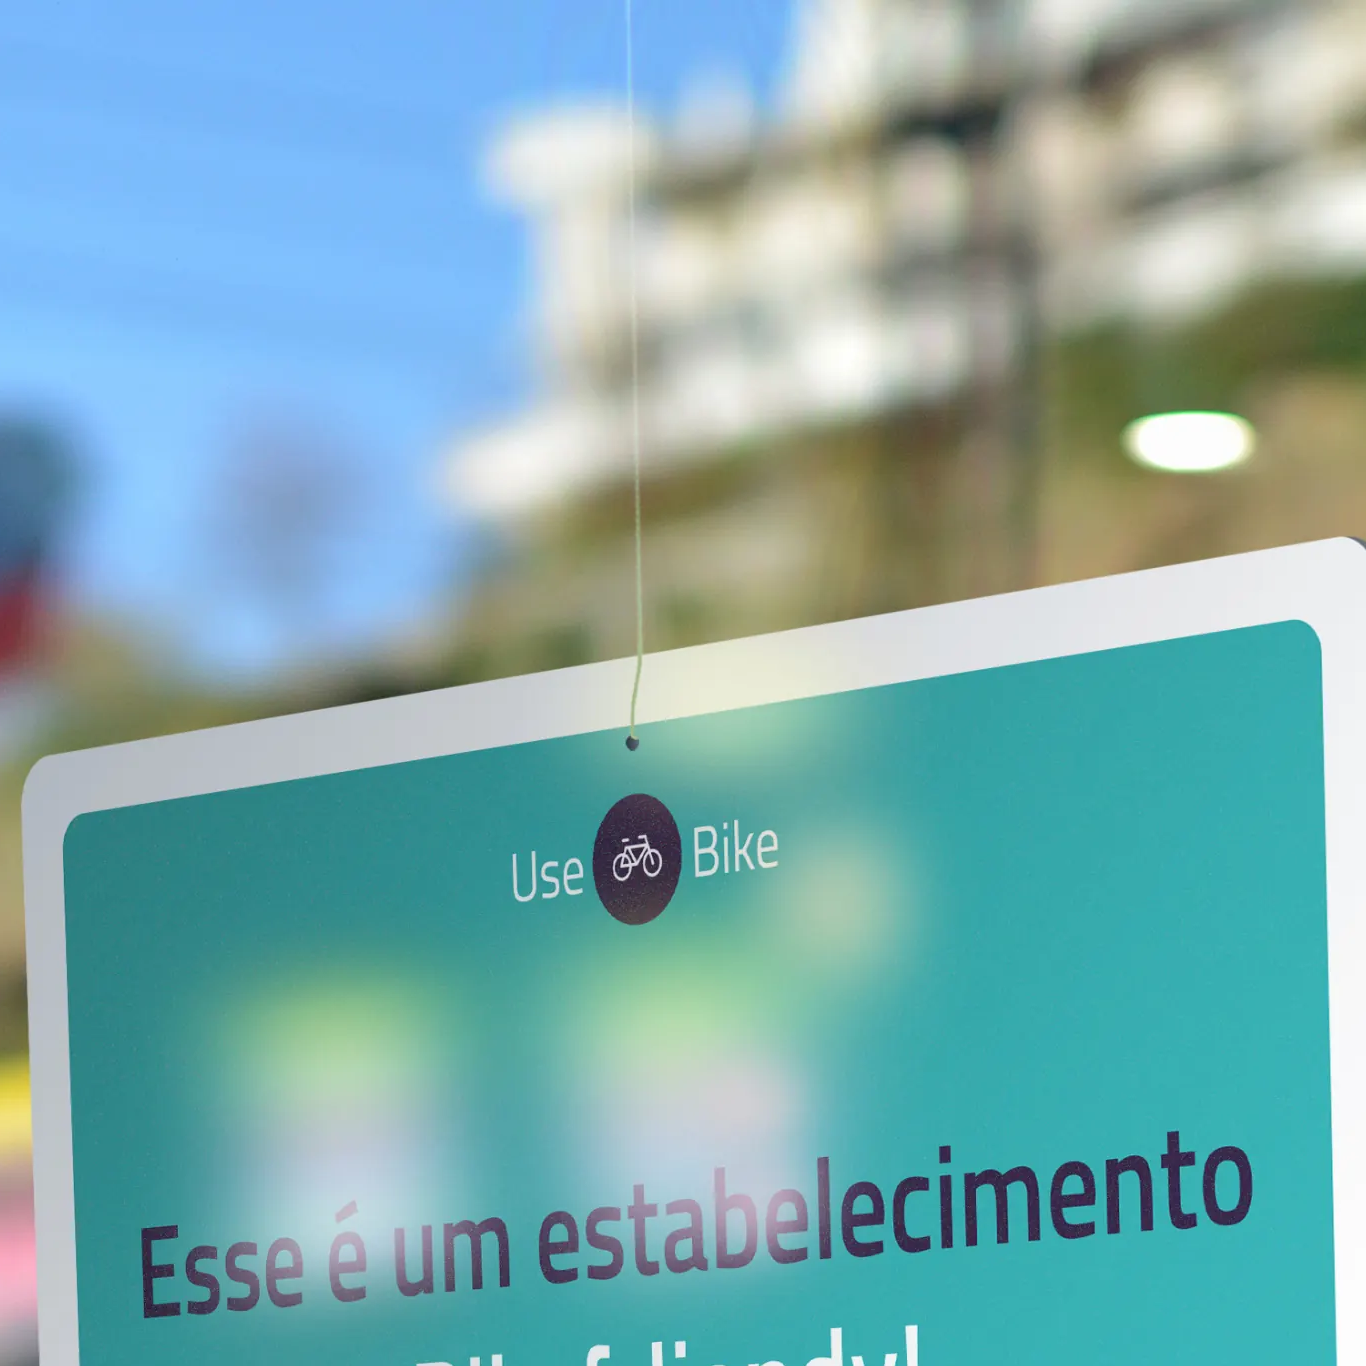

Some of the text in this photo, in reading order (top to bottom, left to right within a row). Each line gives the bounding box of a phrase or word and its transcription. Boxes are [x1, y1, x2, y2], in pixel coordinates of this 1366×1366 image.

[512, 819, 779, 903] Use Bike
[141, 1130, 1253, 1319] Esse é um estabelecimento
